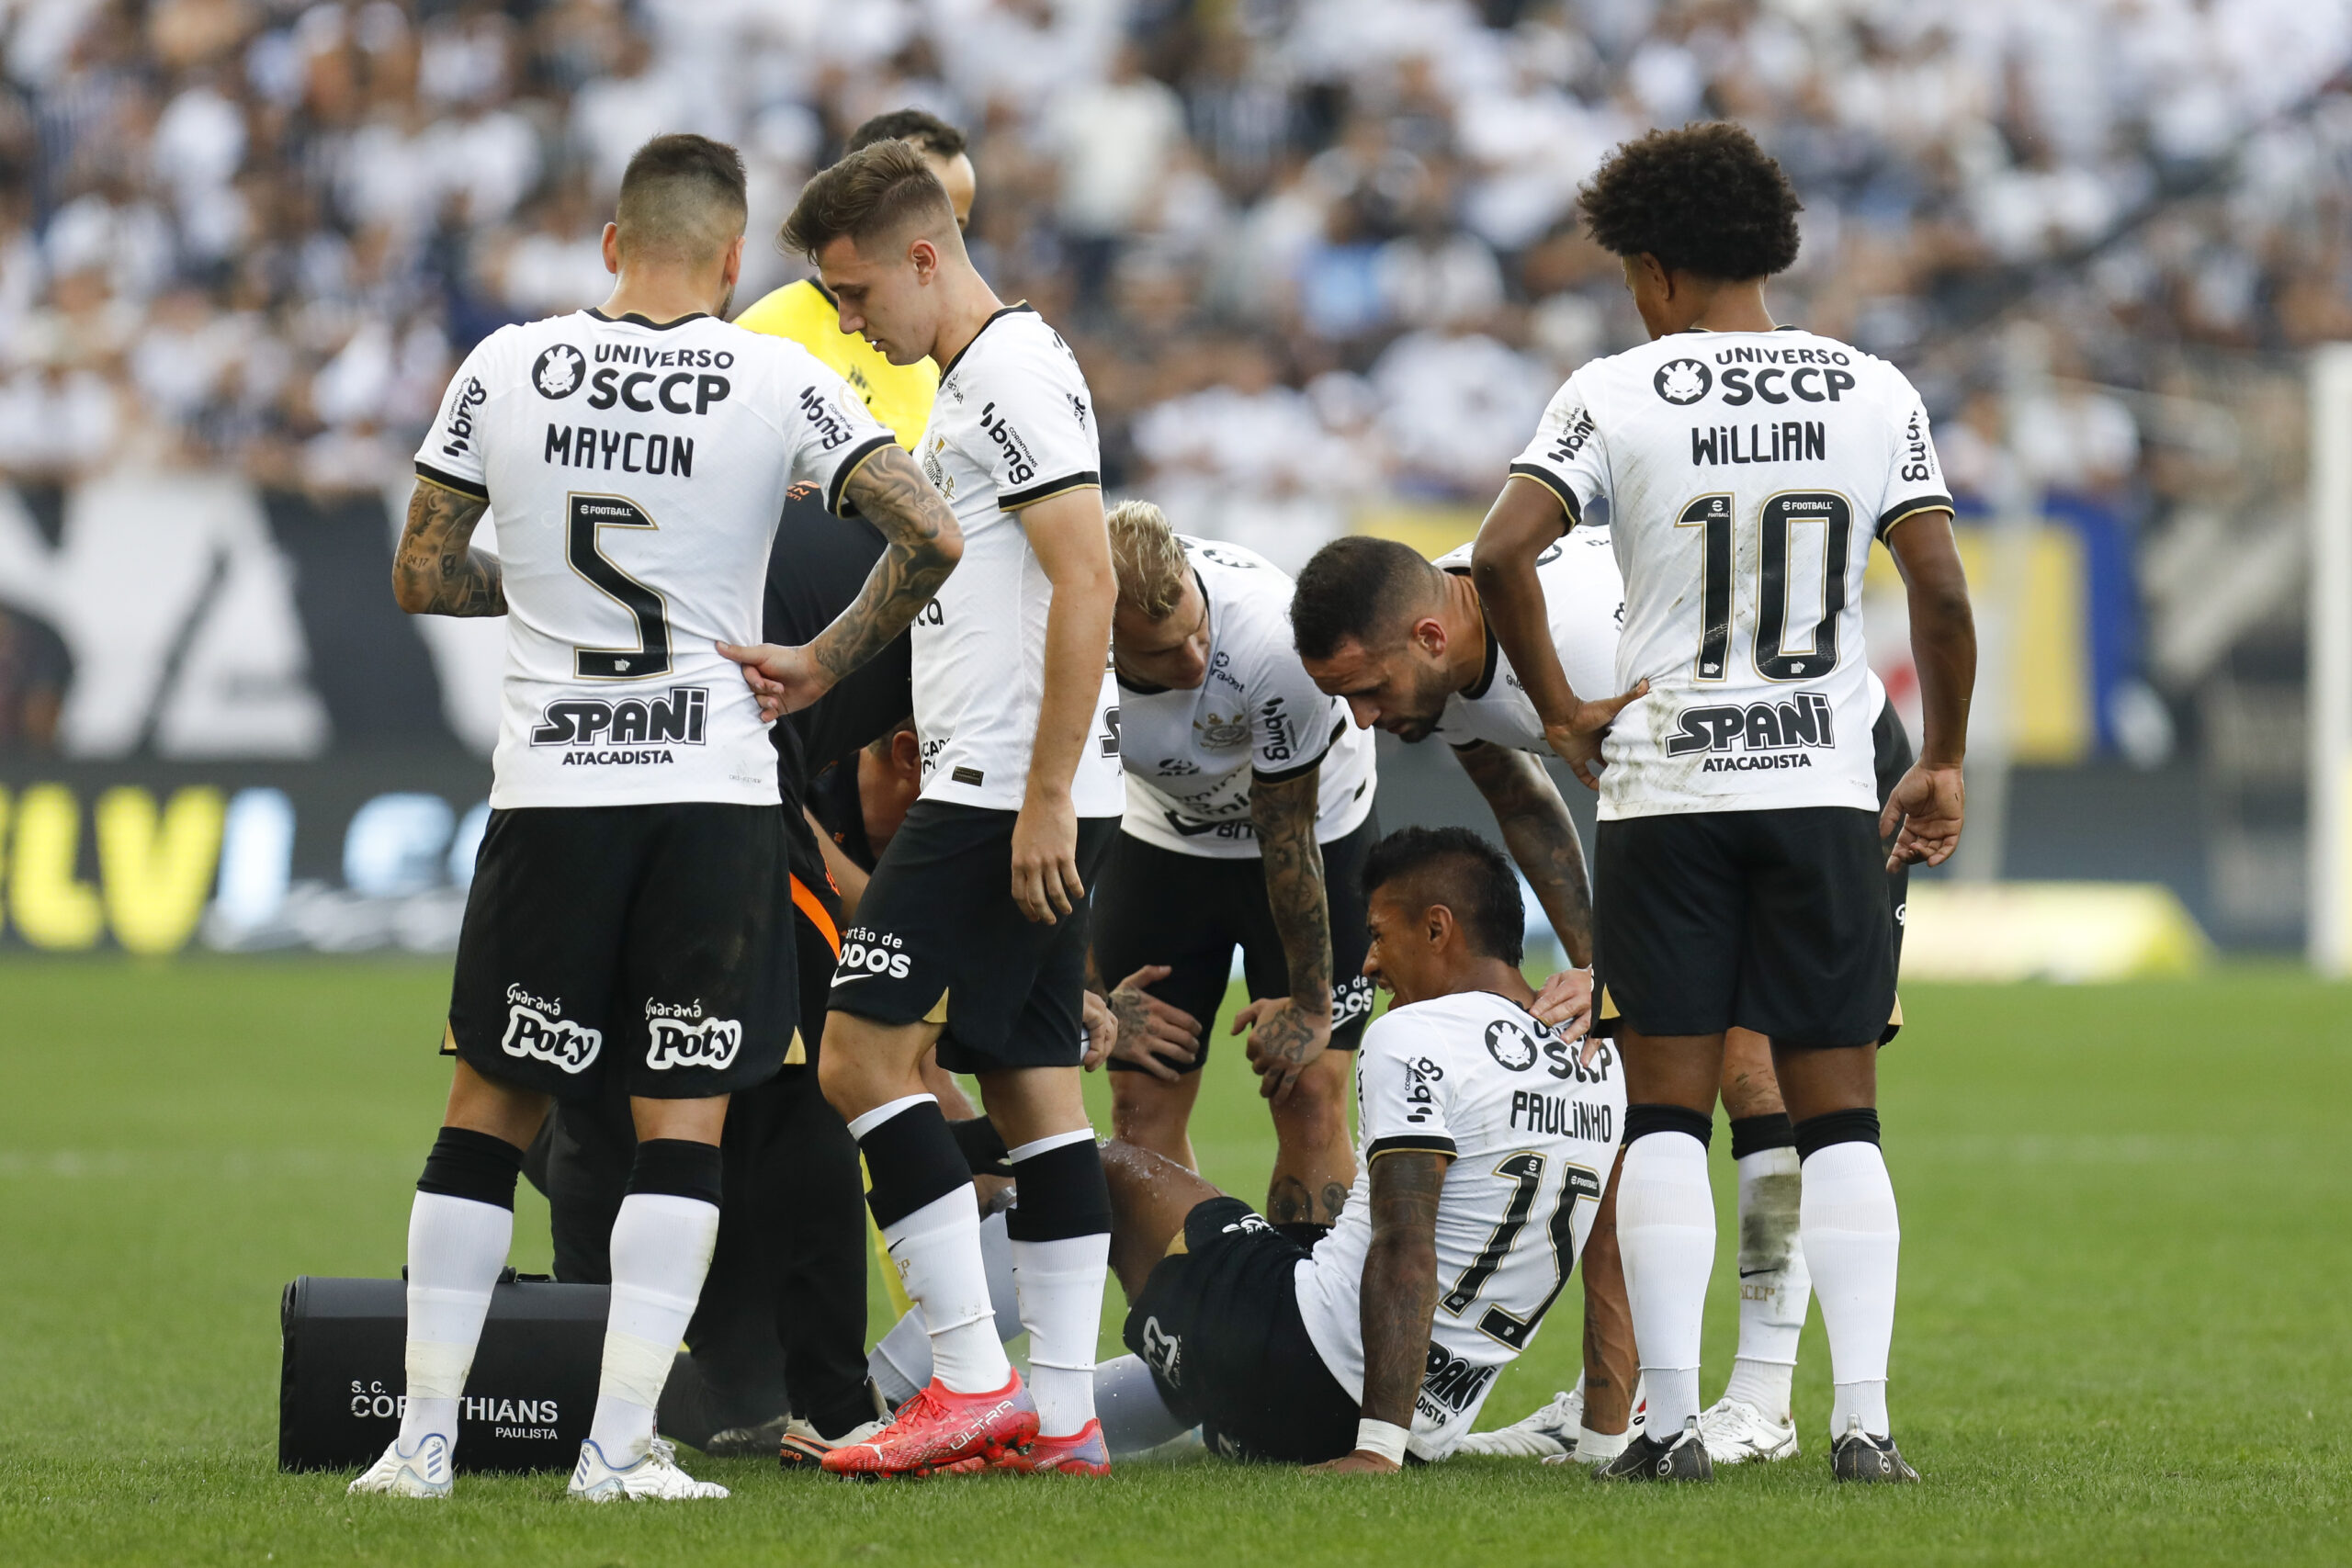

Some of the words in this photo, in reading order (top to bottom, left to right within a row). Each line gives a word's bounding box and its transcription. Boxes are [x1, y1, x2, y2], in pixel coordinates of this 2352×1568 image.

[594, 344, 734, 369] UNIVERSO
[1715, 347, 1850, 367] UNIVERSO
[447, 376, 487, 439] bmg
[587, 367, 730, 415] SCCP
[1721, 367, 1856, 406] SCCP
[807, 396, 853, 450] bmg
[545, 423, 695, 478] MAYCON
[988, 418, 1035, 485] bmg
[1009, 426, 1038, 468] CORINTHIANS
[566, 491, 673, 681] 5
[1674, 489, 1855, 683] 10
[562, 750, 673, 765] ATACADISTA
[1263, 713, 1291, 761] bmg
[1702, 753, 1812, 773] ATACADISTA
[881, 932, 903, 949] de
[507, 983, 561, 1016] Guaraná
[1352, 975, 1368, 989] de
[645, 997, 702, 1021] Guaraná
[508, 1011, 595, 1066] Poty
[654, 1023, 737, 1066] Poty
[1437, 1150, 1602, 1356] 15
[351, 1380, 366, 1393] S.
[370, 1381, 386, 1393] C.
[495, 1427, 559, 1440] PAULISTA
[949, 1400, 1014, 1450] ULTRA
